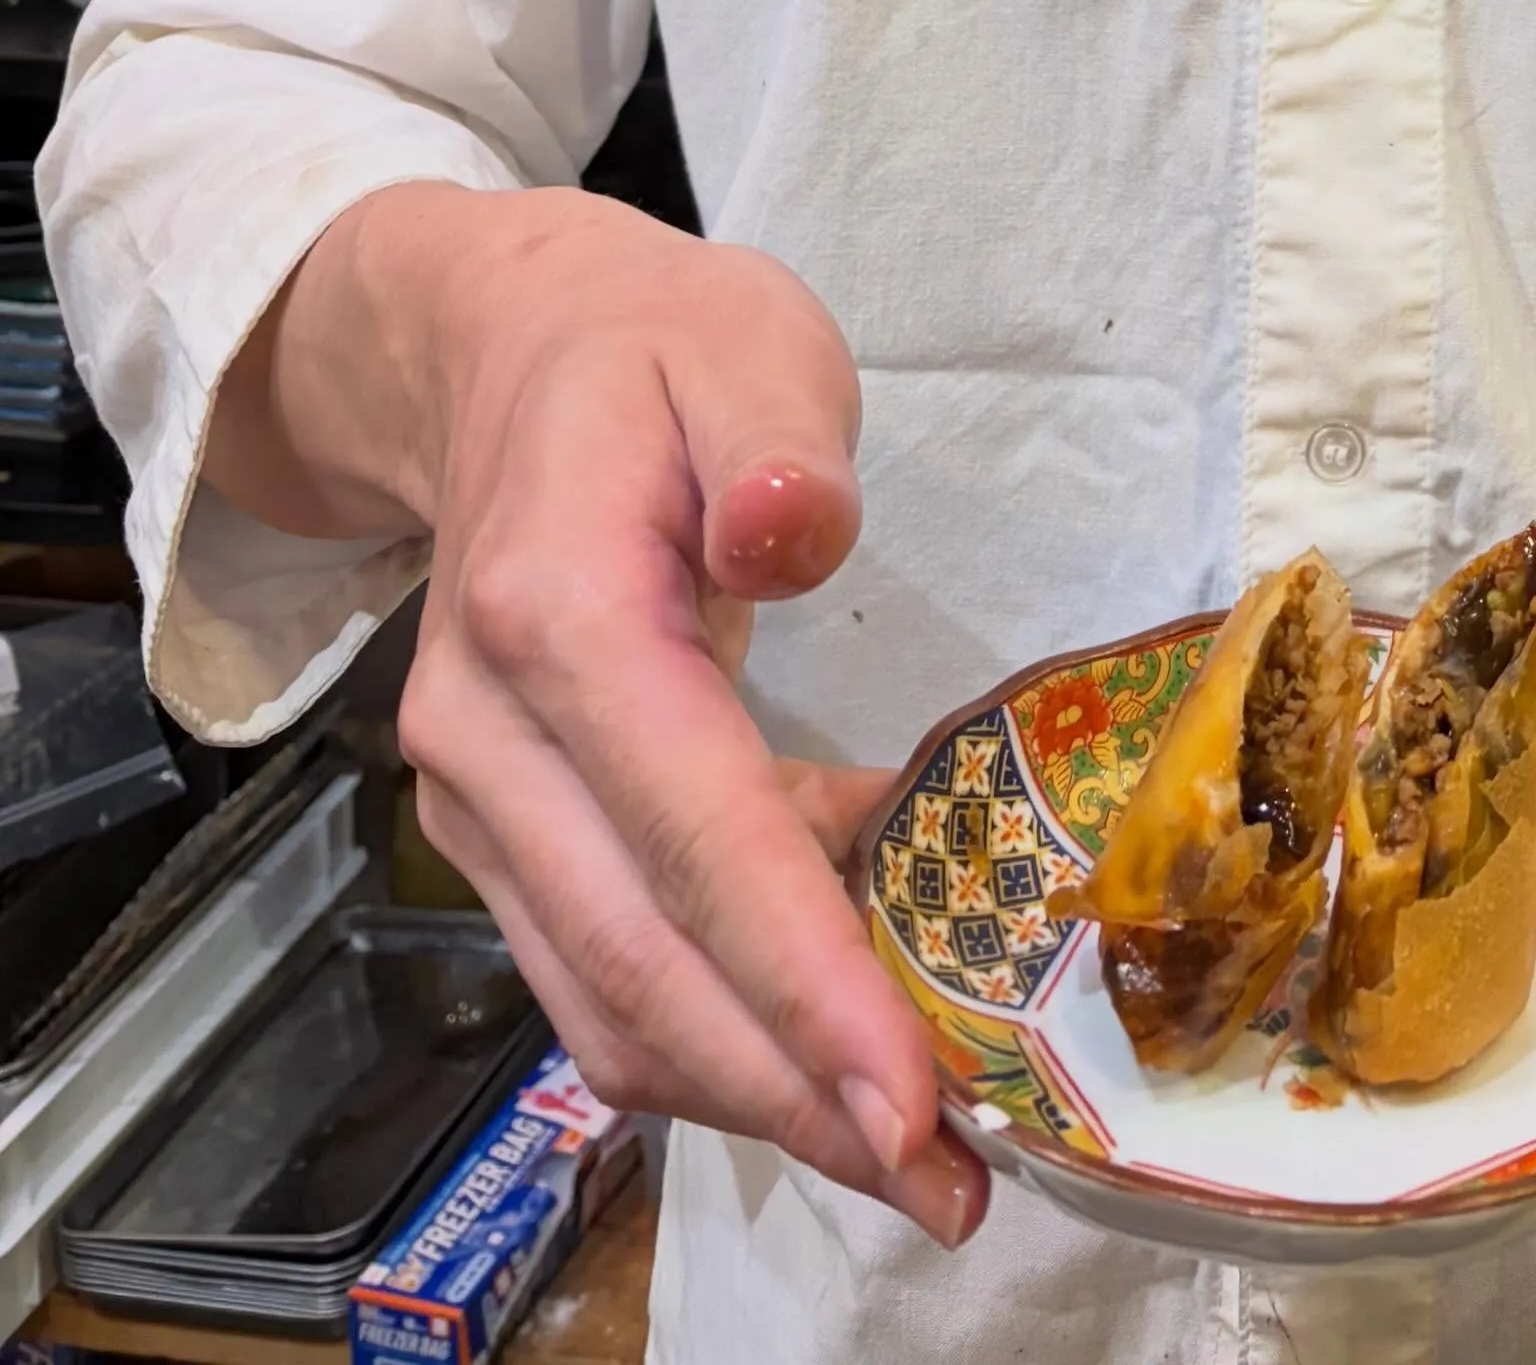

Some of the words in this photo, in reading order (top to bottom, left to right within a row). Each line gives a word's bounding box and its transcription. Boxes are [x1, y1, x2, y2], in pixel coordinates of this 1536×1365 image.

[411, 1160, 512, 1262] FREEZER
[489, 1116, 545, 1166] BAG
[359, 1322, 419, 1354] FREEZER
[420, 1335, 450, 1361] BAG
